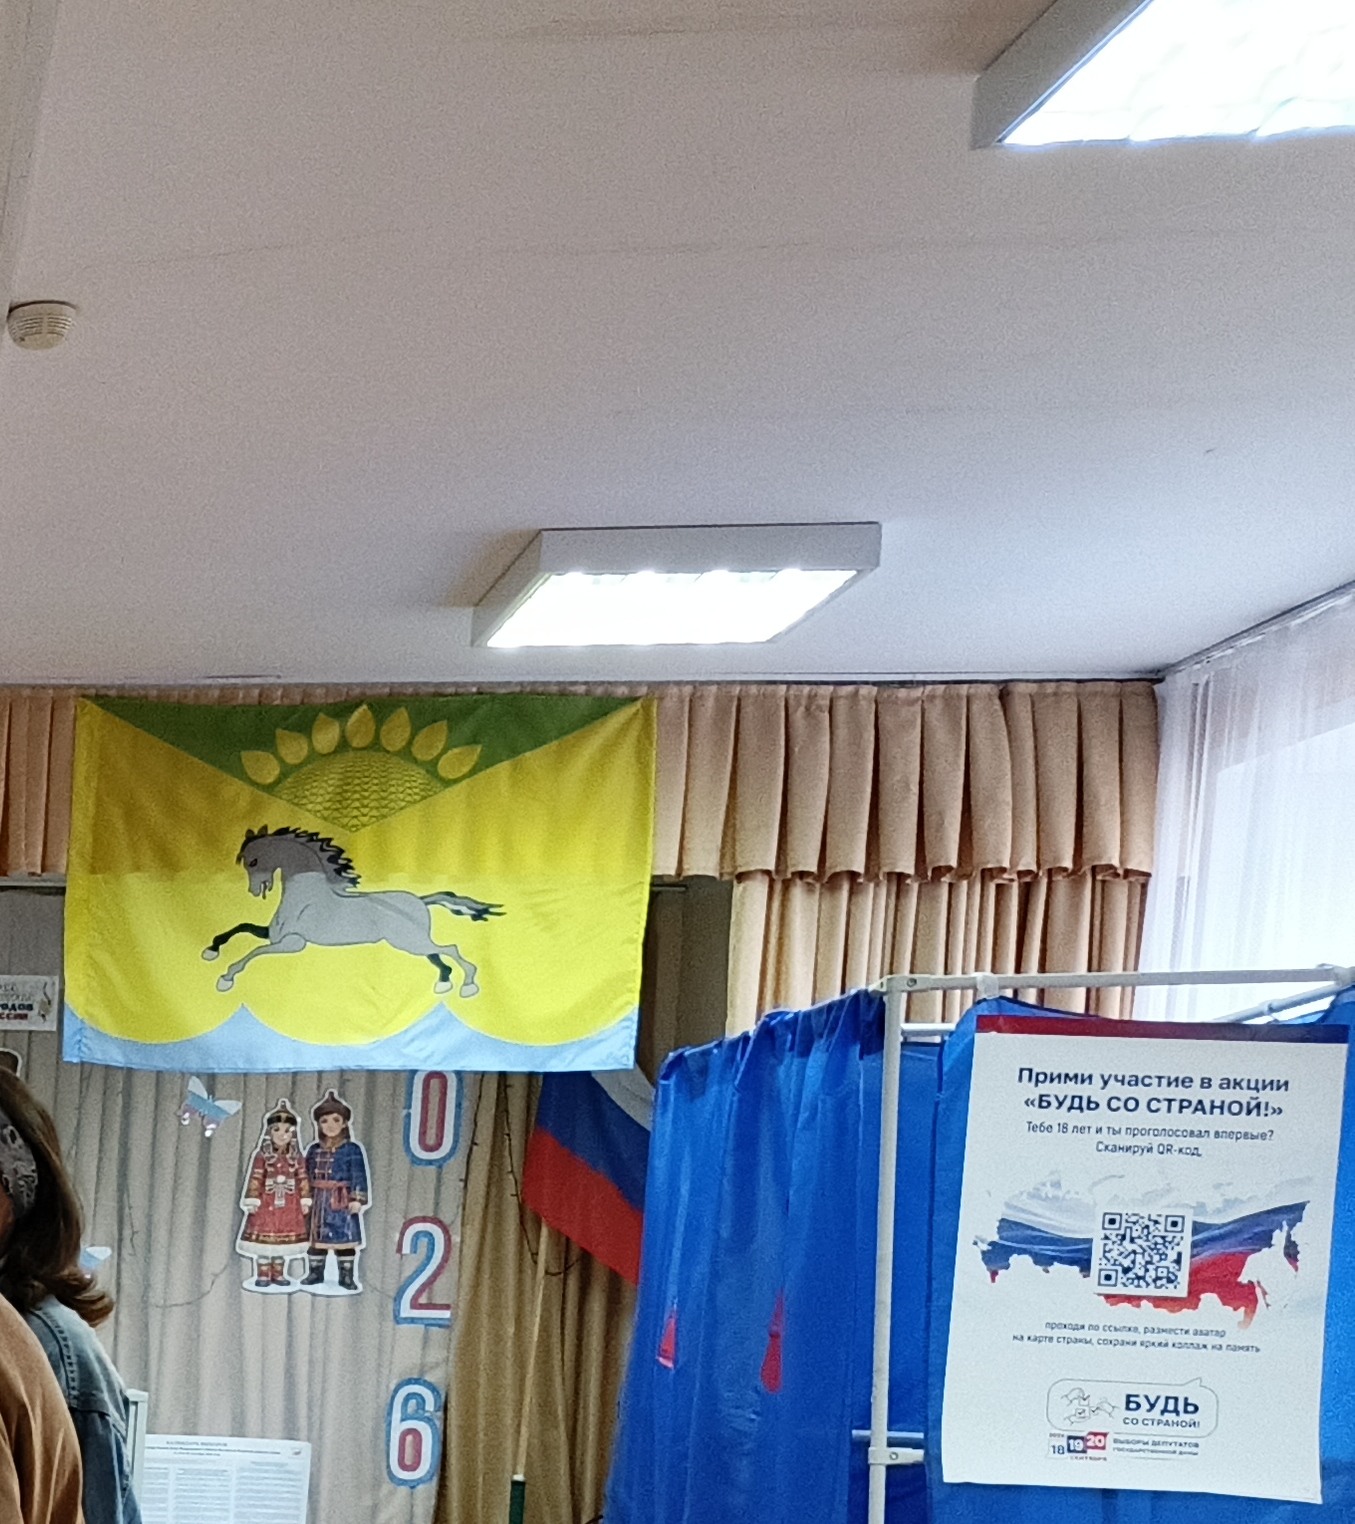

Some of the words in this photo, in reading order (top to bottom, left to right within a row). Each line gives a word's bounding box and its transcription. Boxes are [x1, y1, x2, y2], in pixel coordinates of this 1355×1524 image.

[1017, 1067, 1093, 1087] Прими
[1099, 1072, 1194, 1091] участие
[1199, 1076, 1213, 1090] в
[1217, 1077, 1290, 1094] акции
[1023, 1093, 1100, 1114] «БУДЬ
[1106, 1095, 1140, 1113] СО
[1146, 1096, 1284, 1118] СТРАНОЙ!»
[1026, 1121, 1053, 1134] Тебе
[1057, 1122, 1068, 1134] 18
[1071, 1125, 1092, 1135] лет
[1095, 1126, 1102, 1135] и
[1106, 1126, 1122, 1136] ты
[1124, 1127, 1210, 1140] проголосовал
[1213, 1129, 1274, 1142] впервые?
[1095, 1140, 1154, 1156] Сканируй
[1044, 1321, 1086, 1331] проходи
[1087, 1323, 1100, 1331] по
[1124, 1393, 1200, 1417] БУДЬ
[1122, 1416, 1139, 1426] СО
[1141, 1417, 1201, 1428] СТРАНОЙ!
[1051, 1444, 1065, 1455] 18
[1068, 1439, 1084, 1451] 19
[1086, 1435, 1105, 1447] 20
